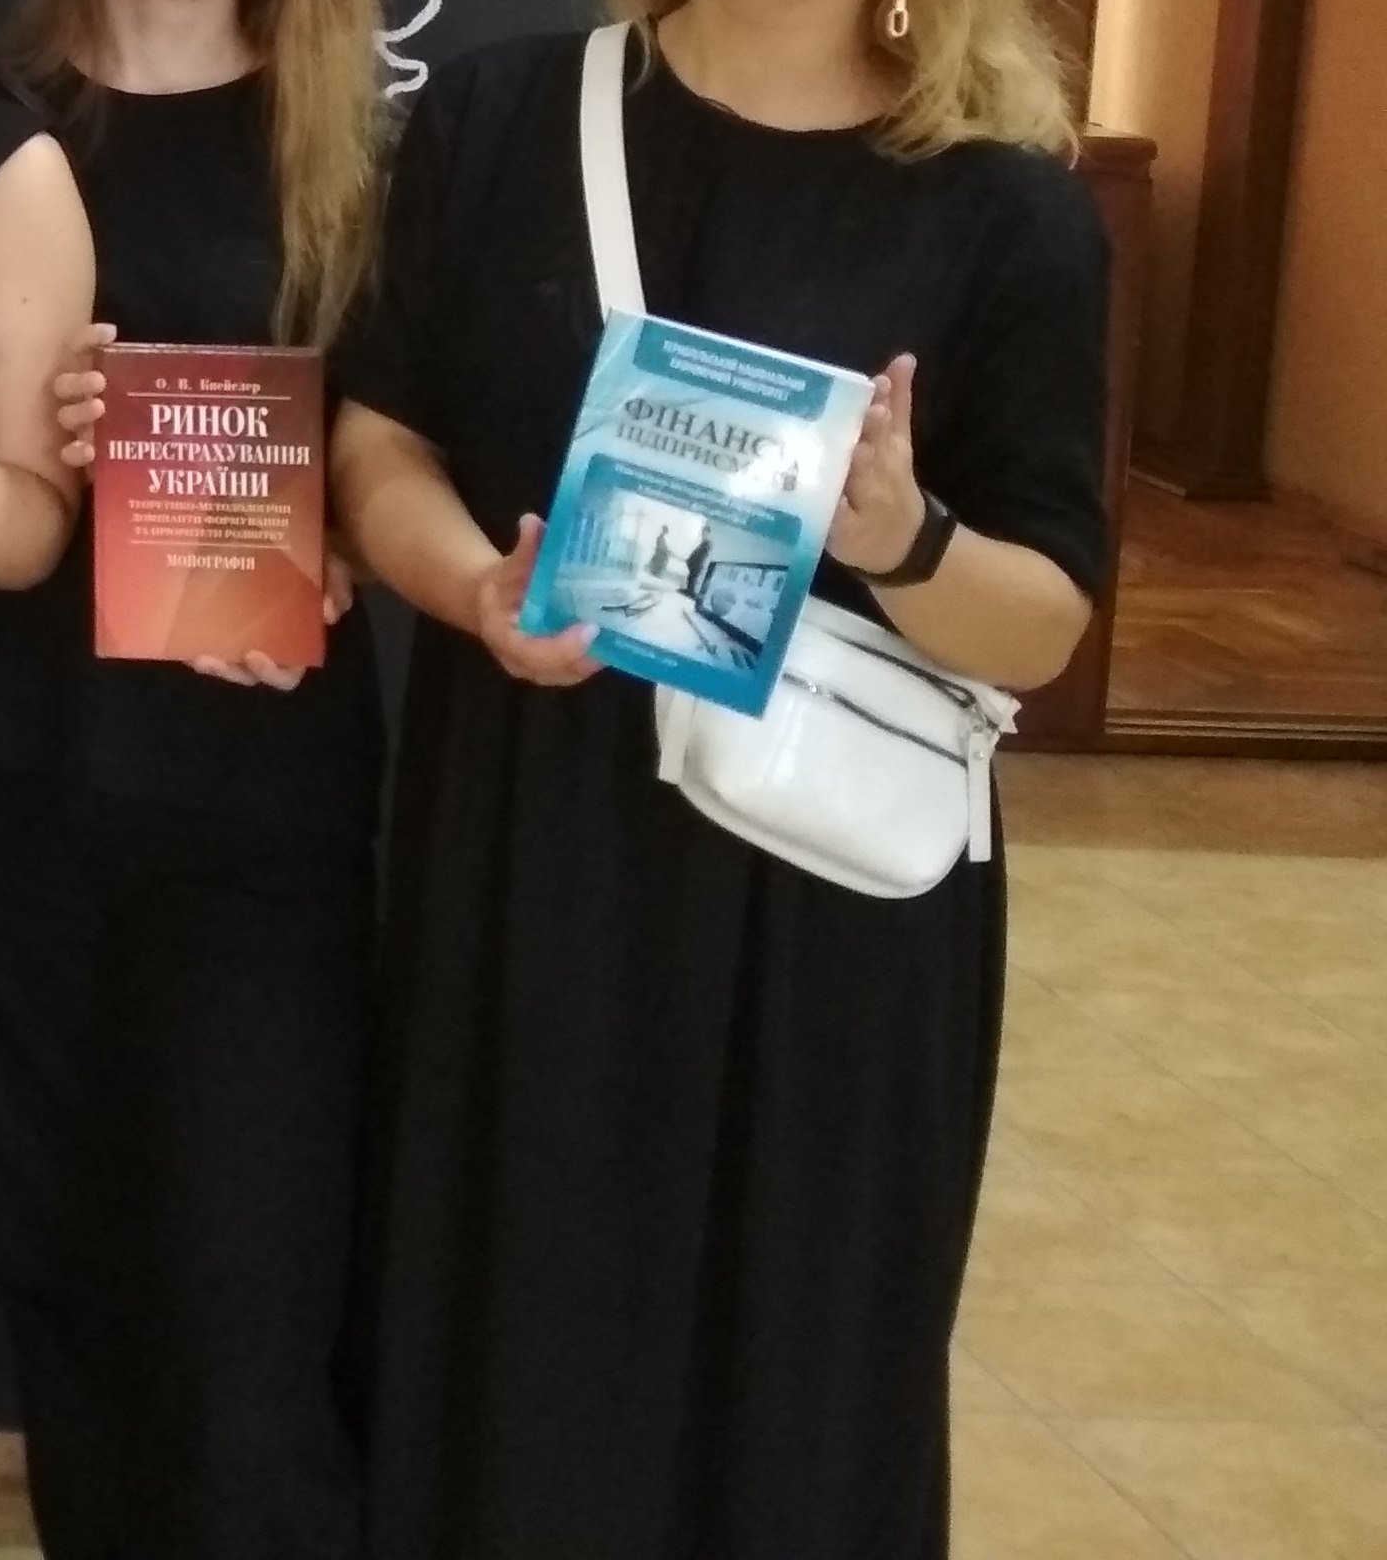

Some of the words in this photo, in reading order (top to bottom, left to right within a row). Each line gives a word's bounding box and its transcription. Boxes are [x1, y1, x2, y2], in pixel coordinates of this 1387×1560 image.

[150, 404, 269, 438] РИНОК
[624, 397, 783, 458] ФІНАНС
[108, 440, 311, 466] ПЕРЕСТРАХУВАННЯ
[148, 466, 269, 498] УКРАЇНИ
[166, 553, 257, 570] МОНОГРАФІЯ
